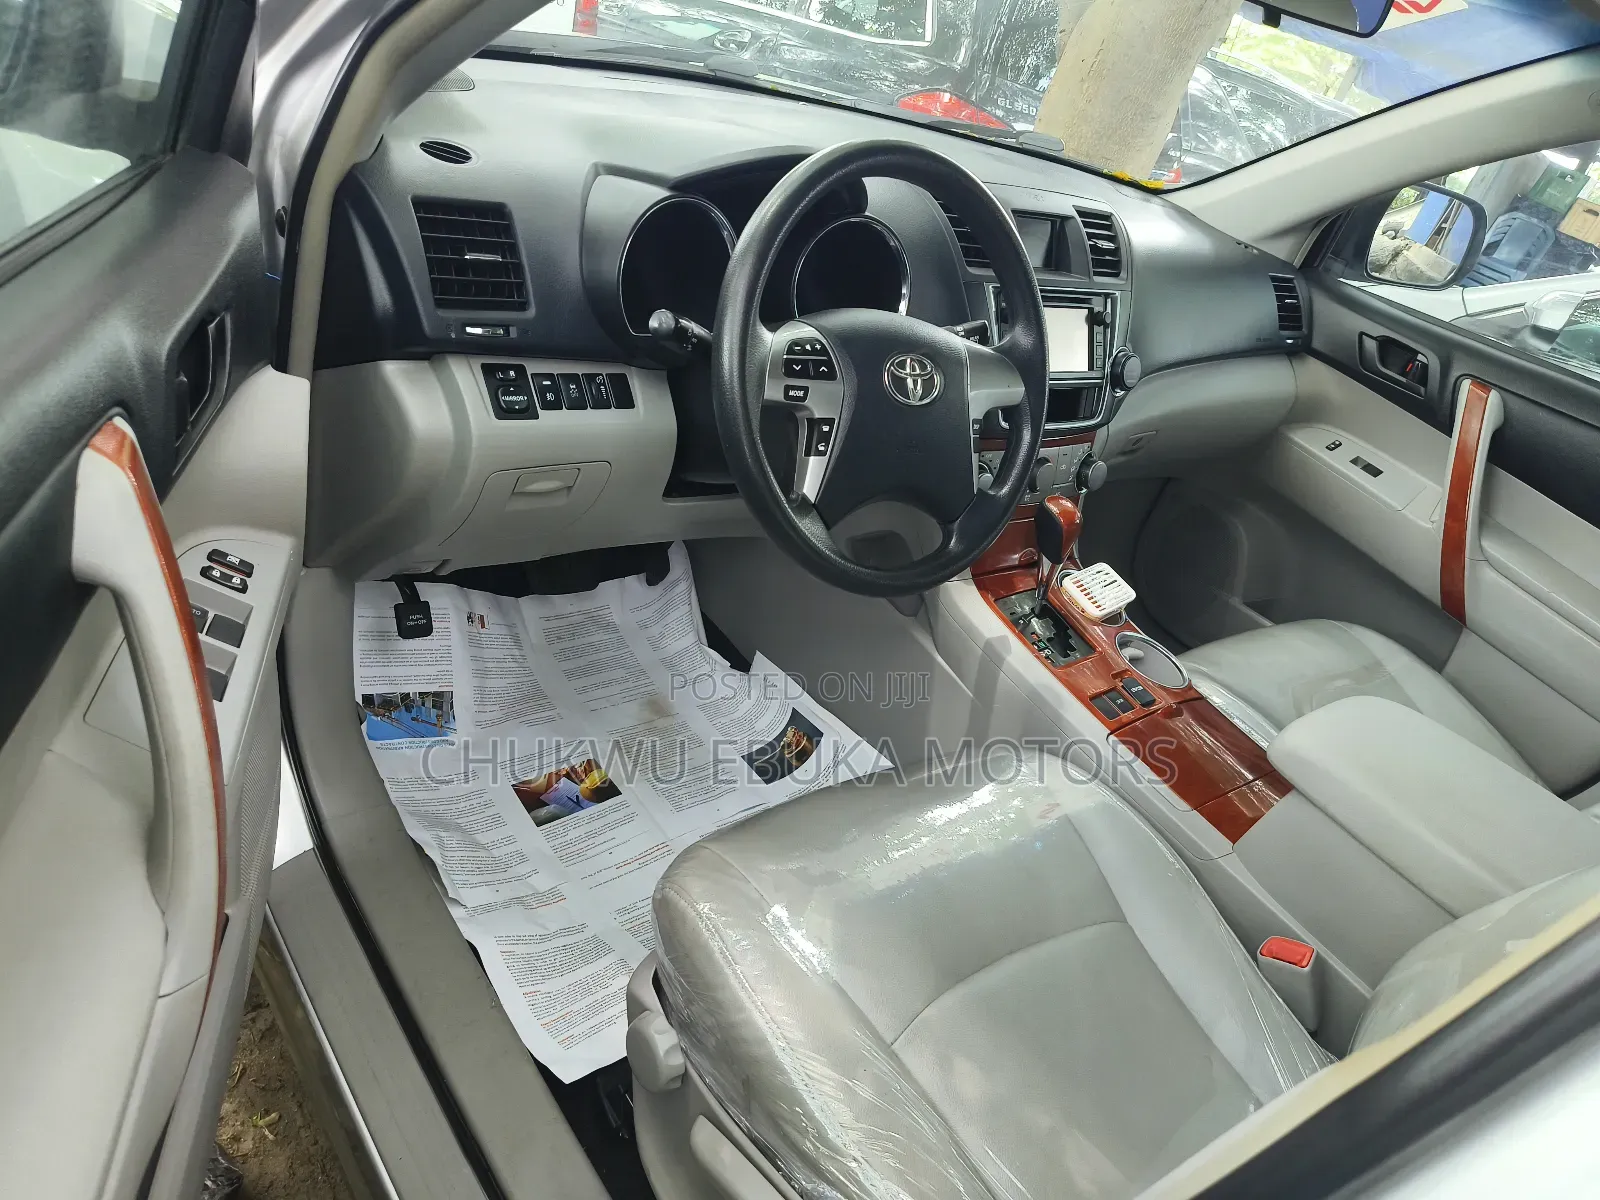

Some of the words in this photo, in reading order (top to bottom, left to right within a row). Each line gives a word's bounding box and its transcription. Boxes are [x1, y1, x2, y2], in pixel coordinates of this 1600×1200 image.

[997, 97, 1013, 109] GL
[509, 370, 516, 378] R
[788, 389, 806, 397] MODE
